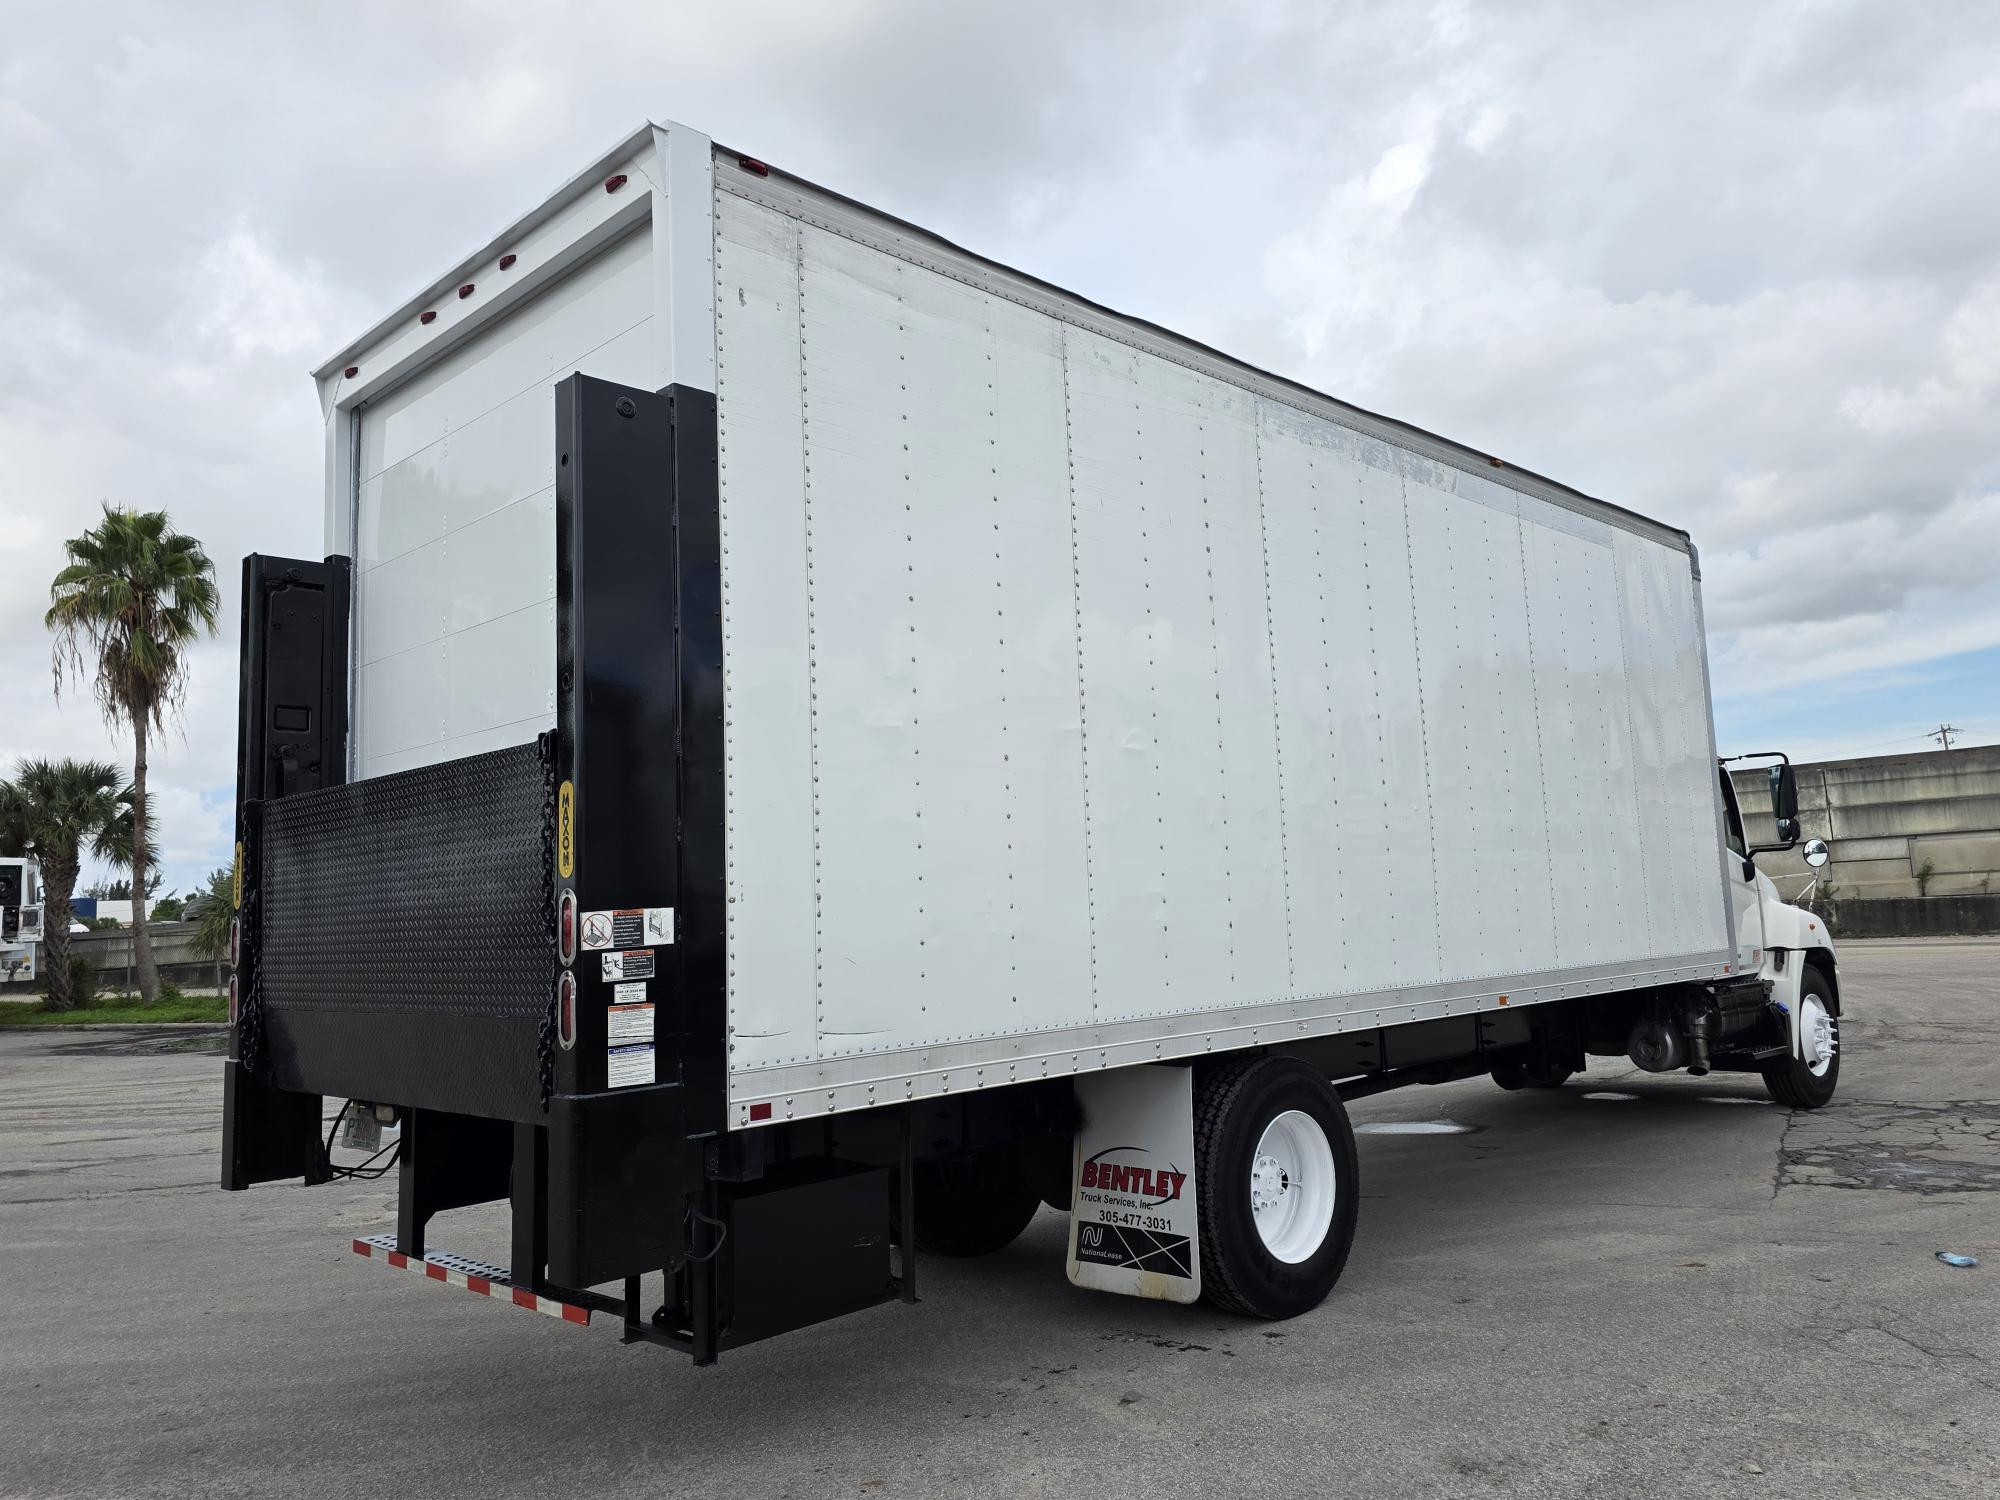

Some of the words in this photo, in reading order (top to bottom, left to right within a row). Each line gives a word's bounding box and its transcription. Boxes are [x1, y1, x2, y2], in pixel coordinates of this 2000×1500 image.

[562, 793, 570, 867] MAXON
[1081, 1161, 1187, 1200] BENTLEY
[1081, 1191, 1102, 1203] Truck
[1103, 1194, 1138, 1210] Services,
[1139, 1199, 1154, 1211] Inc.
[1099, 1209, 1172, 1232] 305-477-3031
